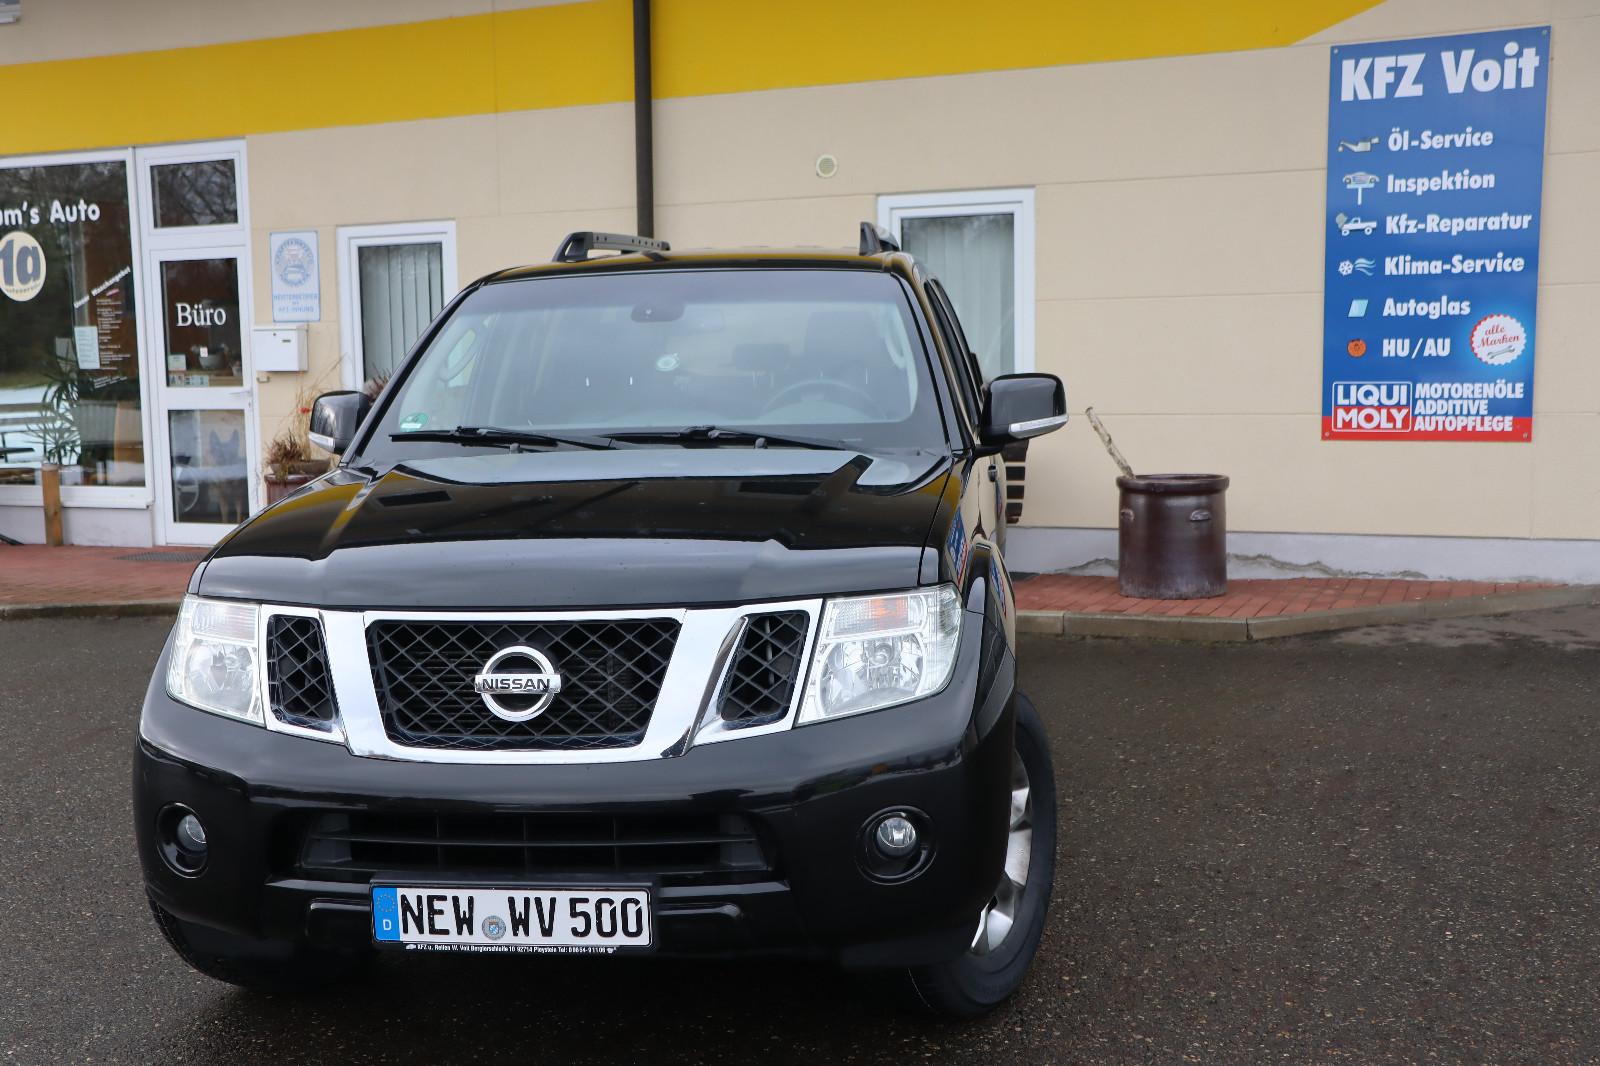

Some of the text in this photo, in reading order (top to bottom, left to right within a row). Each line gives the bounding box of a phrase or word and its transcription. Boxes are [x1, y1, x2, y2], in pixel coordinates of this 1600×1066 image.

[1341, 41, 1540, 101] KFZ Voit
[1388, 126, 1494, 151] Öl-Service
[1387, 169, 1495, 195] Inspektion
[0, 198, 100, 225] m's Auto
[1385, 212, 1533, 236] Kfz-Reparatur
[1384, 252, 1525, 276] Klima-Service
[175, 302, 227, 327] Büro
[1382, 295, 1471, 320] Autoglas
[1484, 324, 1506, 336] alle
[1477, 335, 1520, 349] Marken
[1336, 384, 1408, 406] LIQUI
[1414, 378, 1525, 399] MOTORENÖLE
[1336, 408, 1410, 429] MOLY
[1414, 399, 1489, 415] ADDITIVE
[1413, 415, 1513, 432] AUTOPFLEGE
[482, 678, 550, 690] NISSAN
[382, 918, 392, 931] D
[400, 894, 475, 935] NEW
[507, 896, 557, 937] WV
[569, 897, 643, 938] 500
